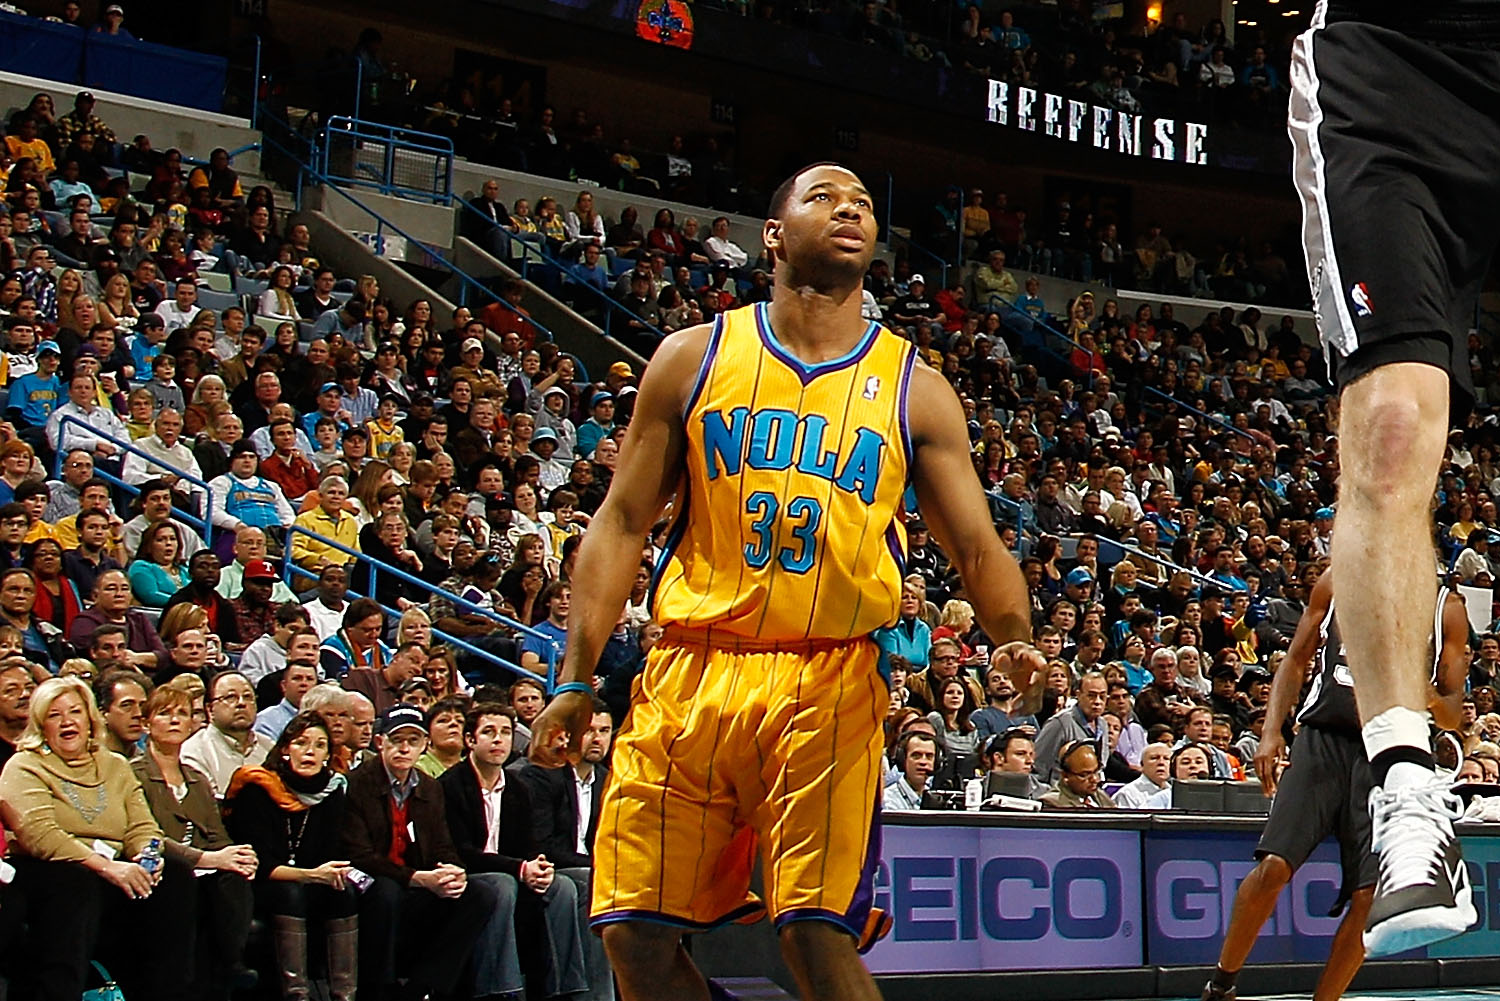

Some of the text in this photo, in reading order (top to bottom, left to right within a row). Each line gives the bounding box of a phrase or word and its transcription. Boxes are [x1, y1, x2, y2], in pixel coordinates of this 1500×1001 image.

[701, 407, 888, 506] NOLA
[263, 562, 273, 572] T
[744, 490, 822, 574] 33
